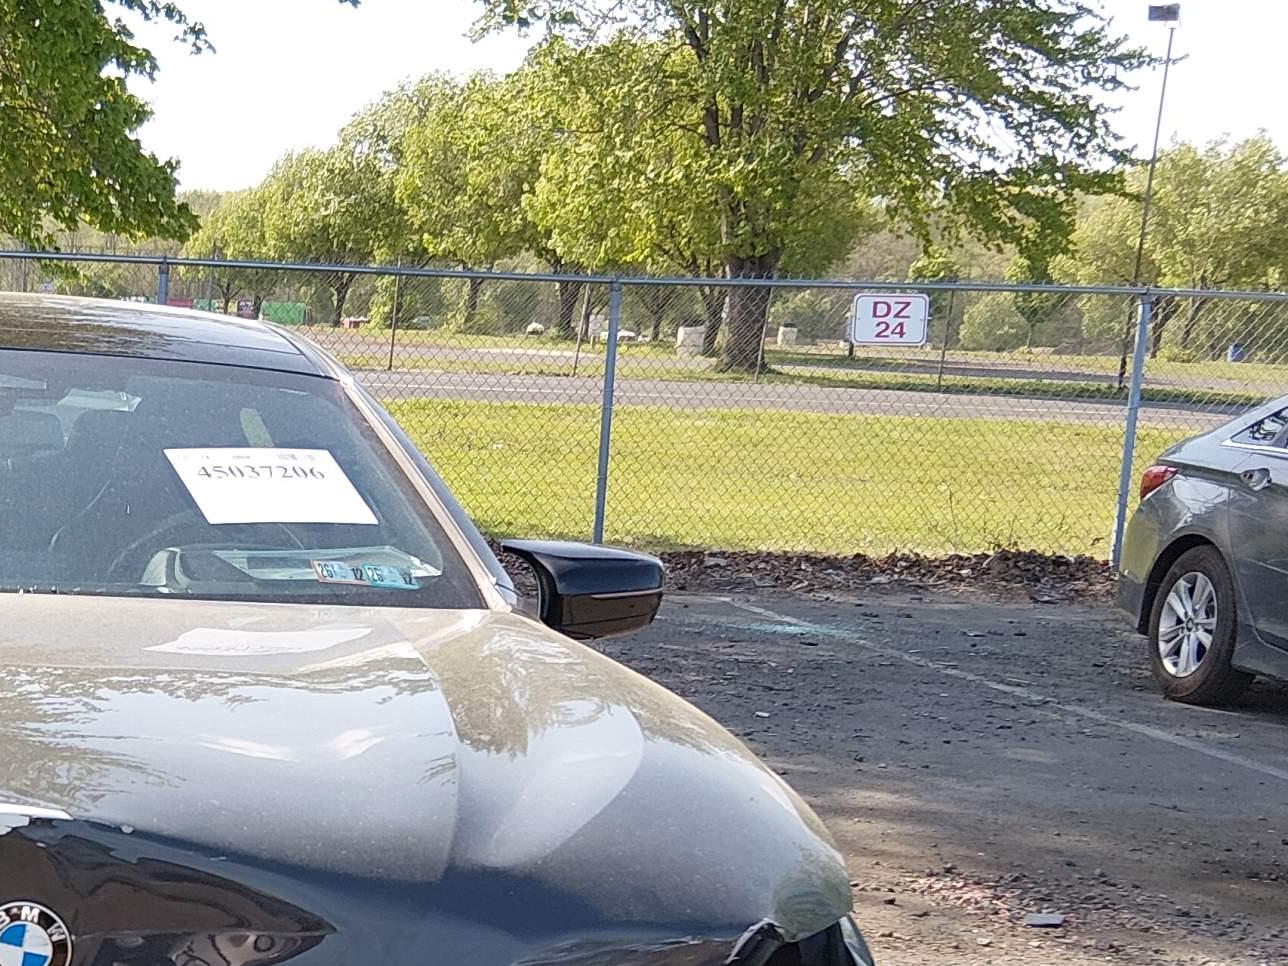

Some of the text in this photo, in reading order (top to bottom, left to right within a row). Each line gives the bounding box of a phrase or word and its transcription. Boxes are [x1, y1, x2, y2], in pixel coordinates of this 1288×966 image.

[872, 301, 912, 319] DZ
[874, 321, 906, 338] 24
[197, 465, 325, 479] 45037206
